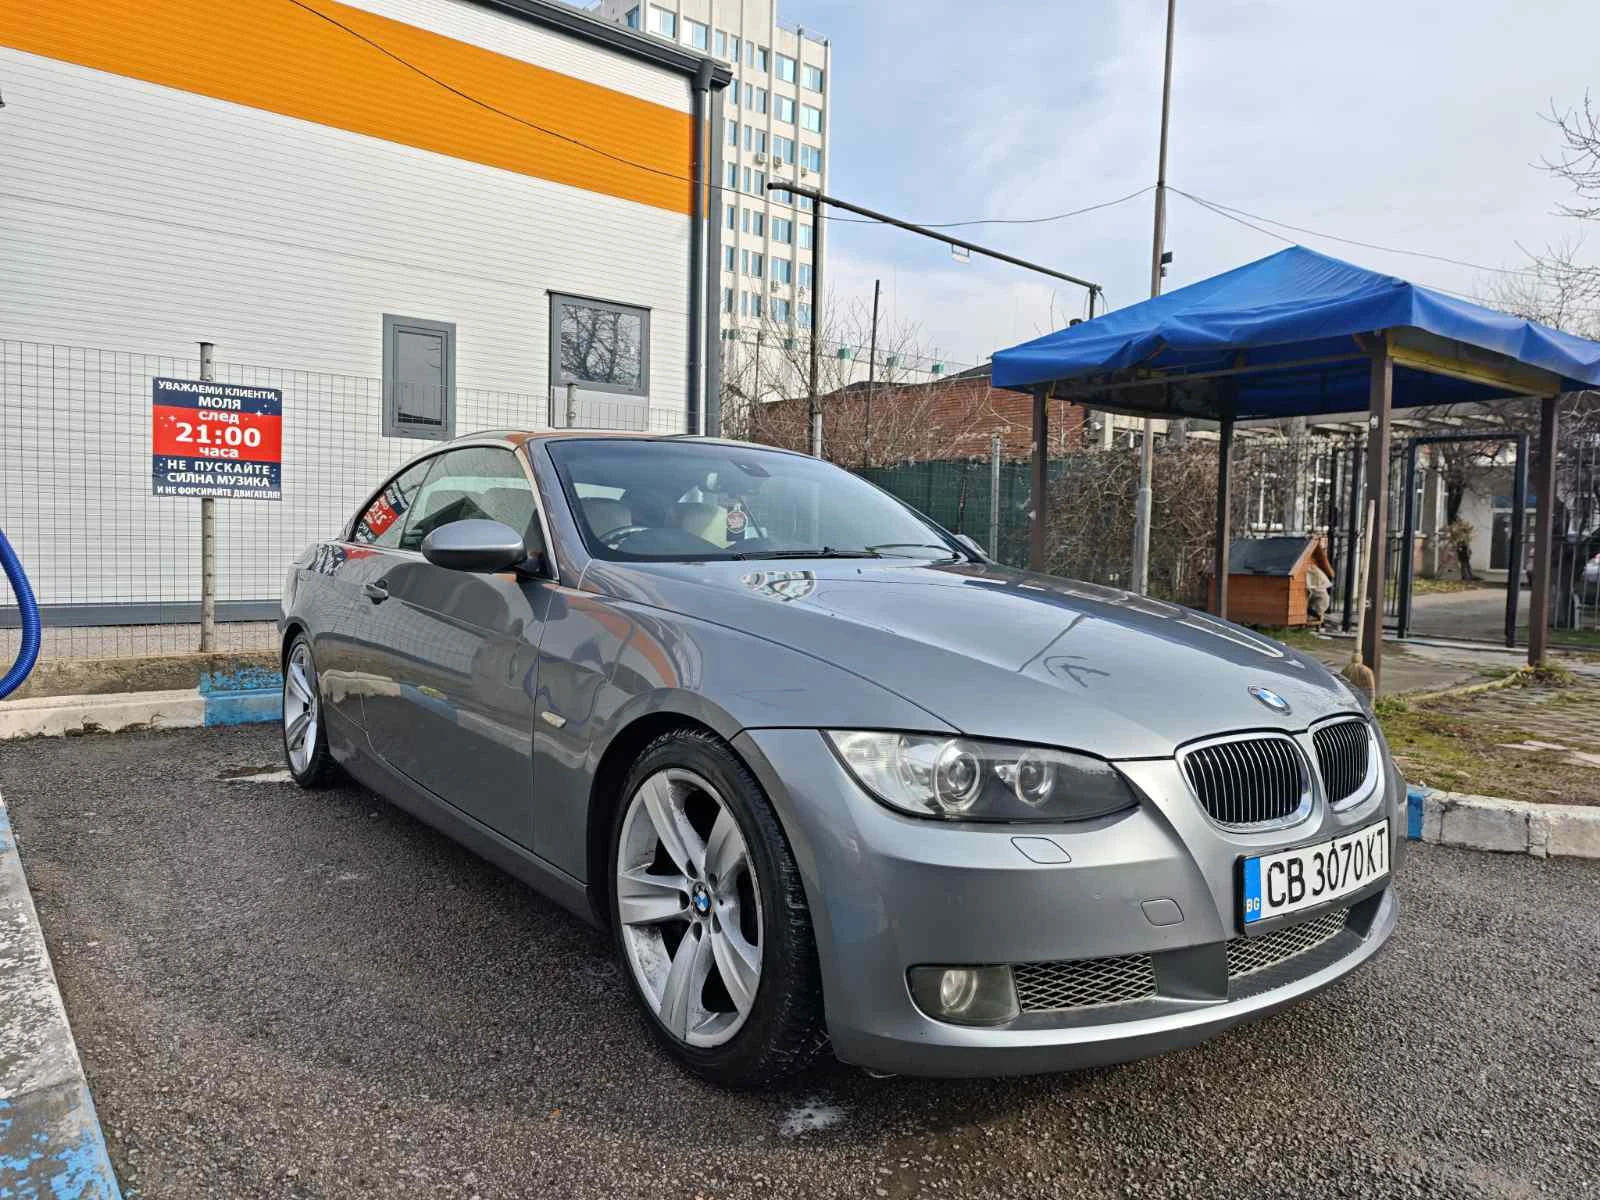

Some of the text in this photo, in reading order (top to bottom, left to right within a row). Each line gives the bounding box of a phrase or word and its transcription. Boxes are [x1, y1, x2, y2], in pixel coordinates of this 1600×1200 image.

[158, 380, 278, 401] УВАЖАЕМИ КЛИЕНТИ,
[198, 395, 241, 409] МОЛЯ
[198, 410, 240, 424] след
[175, 422, 261, 447] 21:00
[199, 446, 239, 458] часа
[167, 459, 270, 475] НЕ ПУСКАЙТЕ
[167, 472, 270, 487] СИЛНА МУЗИКА
[165, 486, 177, 495] НЕ
[177, 486, 232, 497] ФОРСИРАЙТЕ
[233, 489, 280, 499] ДВИГАТЕЛЯ!
[1246, 898, 1260, 913] BG
